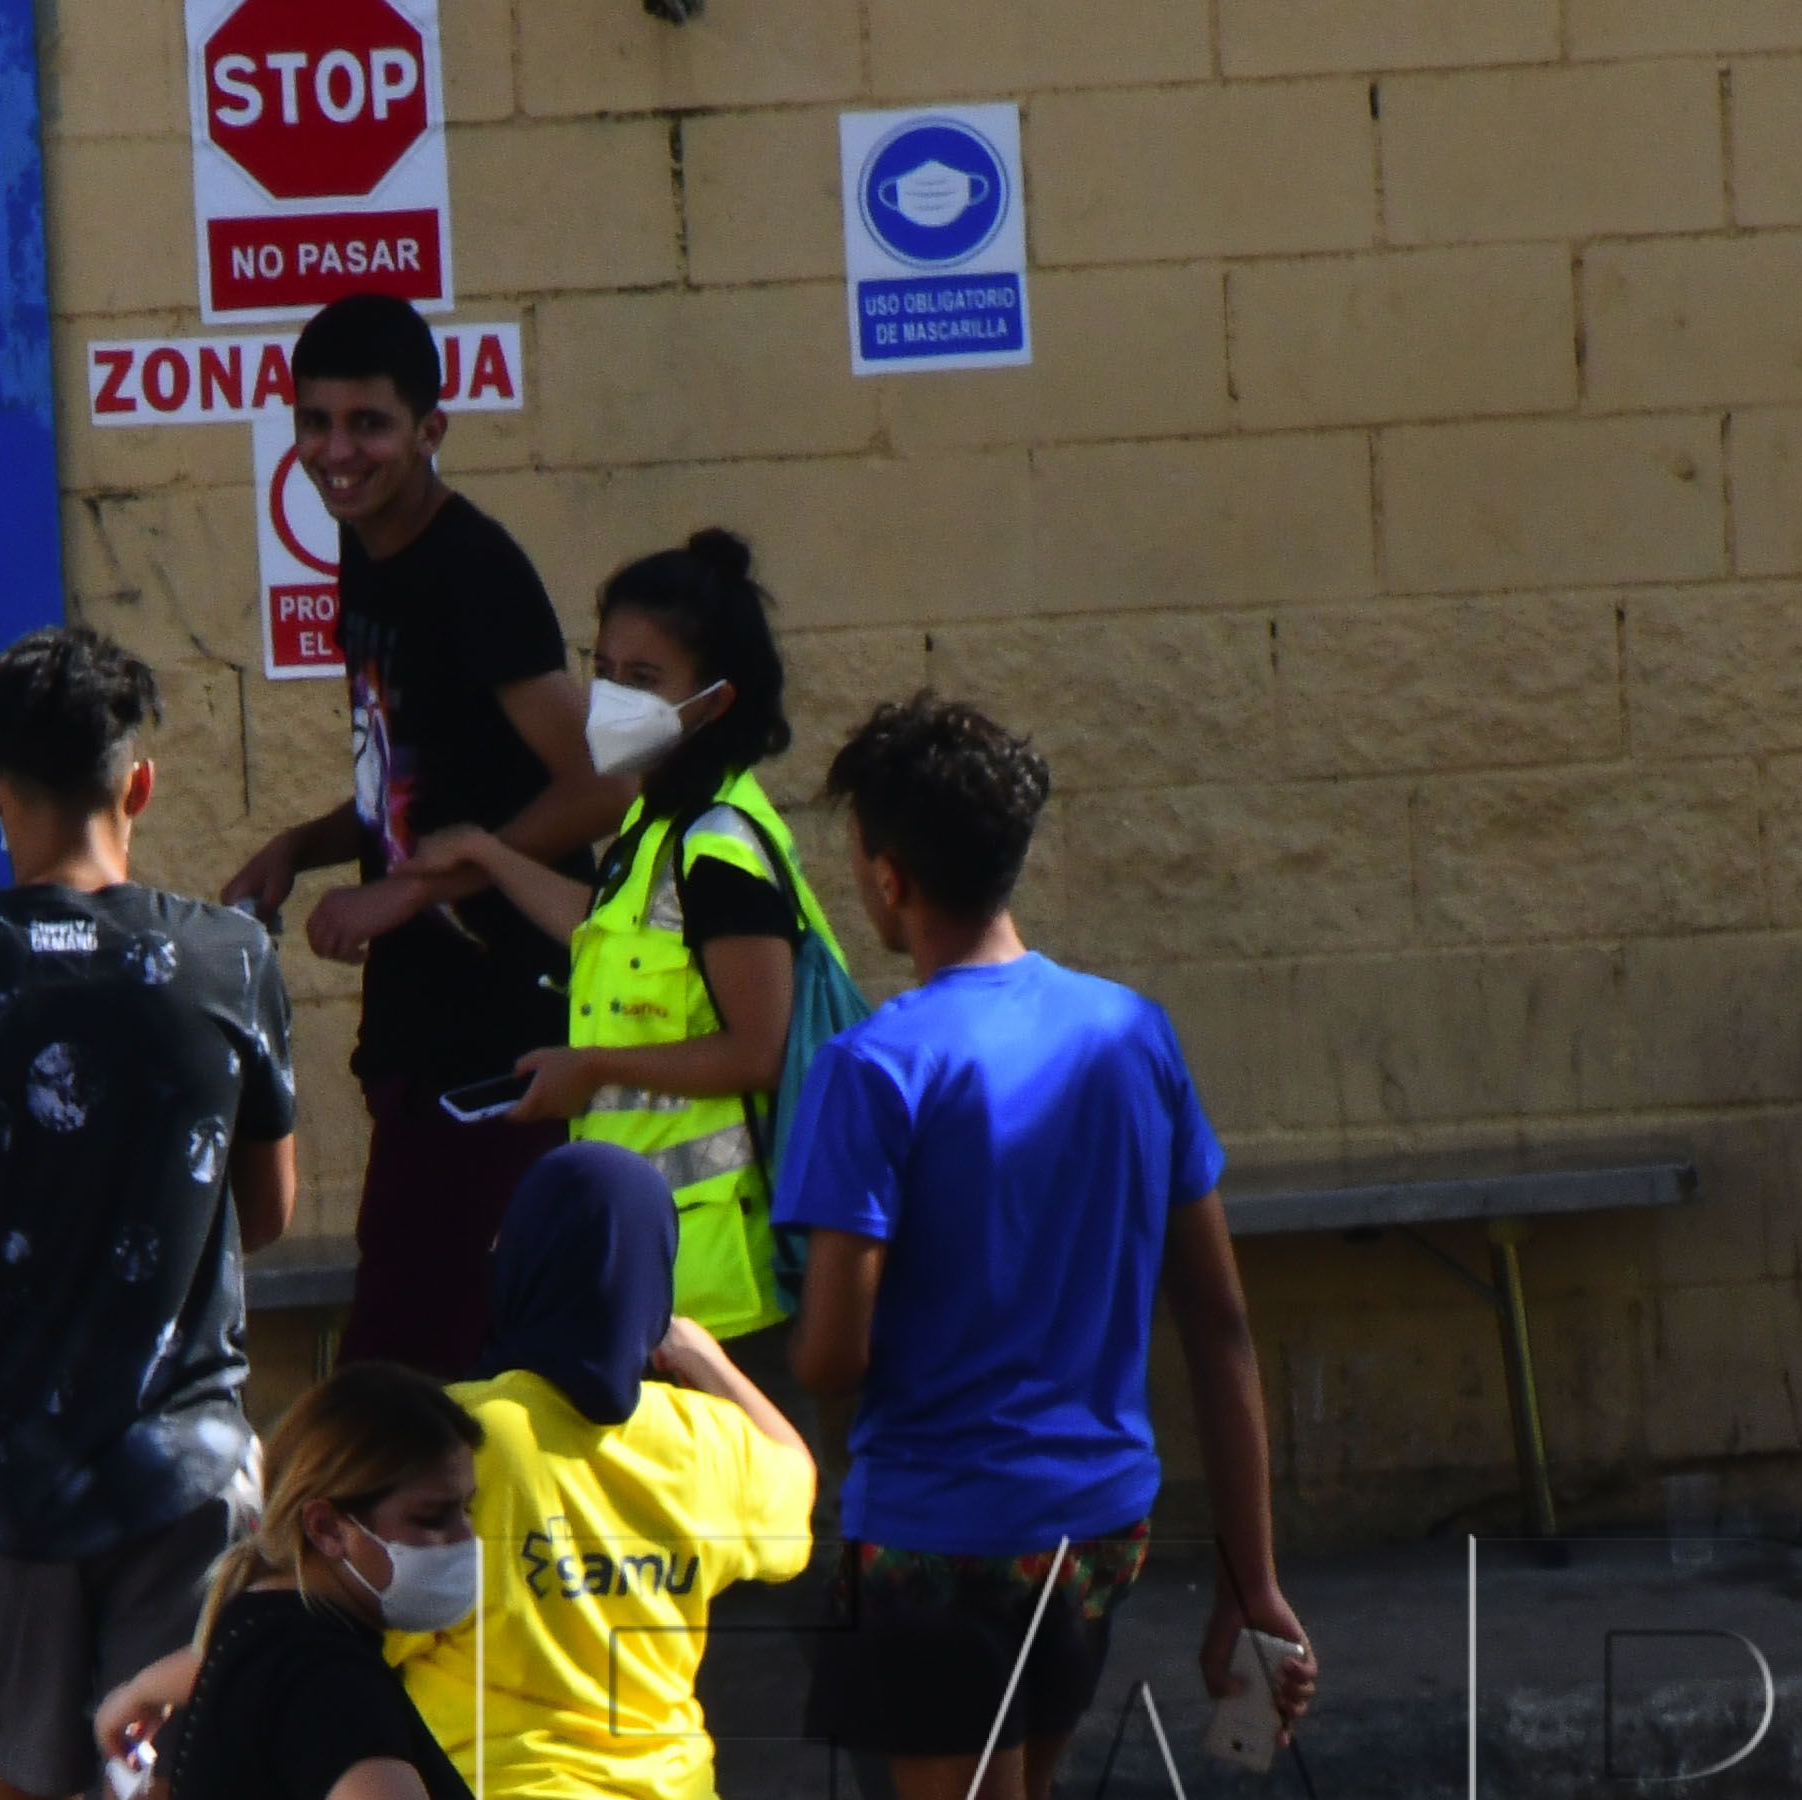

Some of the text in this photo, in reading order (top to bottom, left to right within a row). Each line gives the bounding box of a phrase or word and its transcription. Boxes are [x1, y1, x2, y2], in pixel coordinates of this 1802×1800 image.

[213, 47, 419, 128] STOP
[231, 236, 421, 280] NO PASAR
[865, 287, 1017, 316] USO OBLIGATORIO
[876, 317, 1008, 345] DE MASCARILLA
[94, 334, 515, 415] ZONA JA
[280, 594, 337, 622] PRO
[299, 632, 333, 658] EL
[556, 1551, 700, 1599] samu
